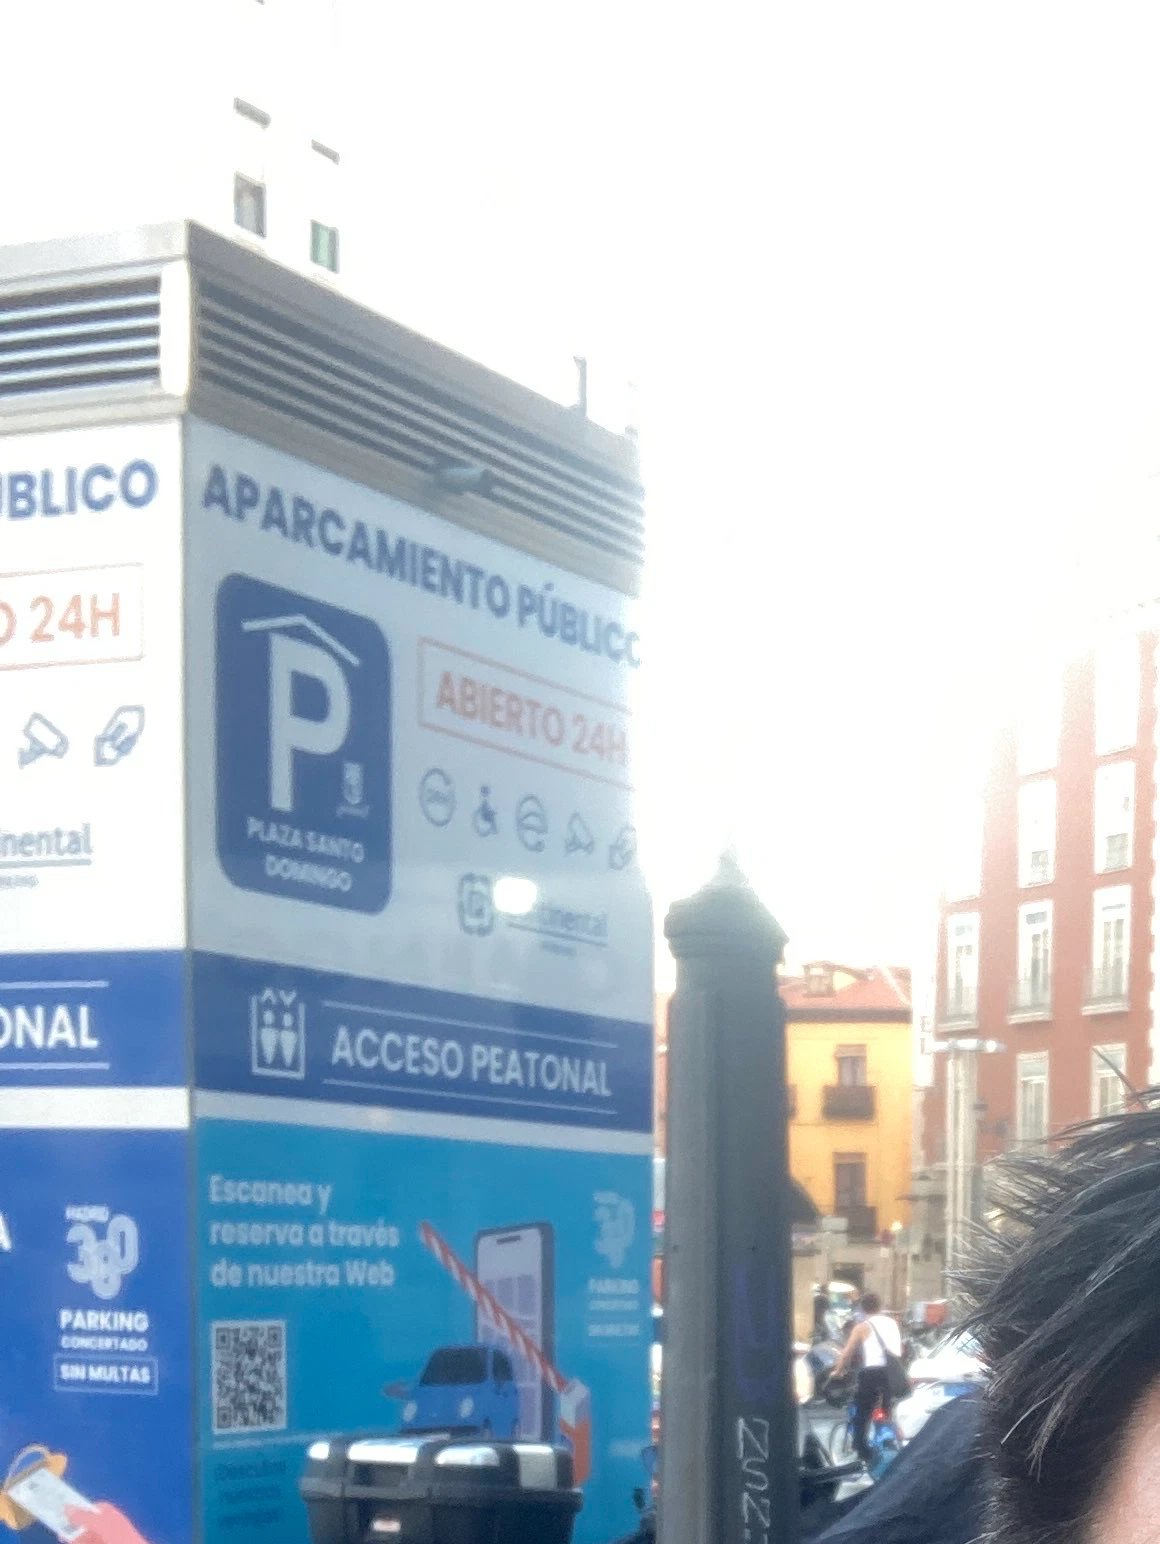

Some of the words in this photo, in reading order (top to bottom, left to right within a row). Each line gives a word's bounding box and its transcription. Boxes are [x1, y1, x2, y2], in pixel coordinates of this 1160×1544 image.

[0, 458, 159, 521] BLICO
[201, 463, 510, 619] APARCAMIENTO
[30, 592, 120, 643] 24H
[436, 671, 565, 748] ABIERTO
[571, 713, 627, 767] 24H
[246, 816, 303, 849] PLAZA
[306, 830, 366, 864] SANTO
[265, 853, 353, 892] DOMINGO
[331, 1014, 465, 1080] ACCESO
[470, 1042, 613, 1097] PEATONAL
[208, 1174, 313, 1206] Escanea
[317, 1183, 333, 1216] y
[209, 1220, 305, 1247] reserva
[308, 1224, 324, 1248] a
[328, 1217, 400, 1248] través
[210, 1257, 243, 1287] de
[247, 1259, 341, 1288] nuestra
[345, 1259, 397, 1287] Web
[59, 1308, 150, 1333] PARKING
[60, 1334, 149, 1353] CONCERTADO
[60, 1363, 87, 1381] SIN
[89, 1364, 151, 1385] MULTAS
